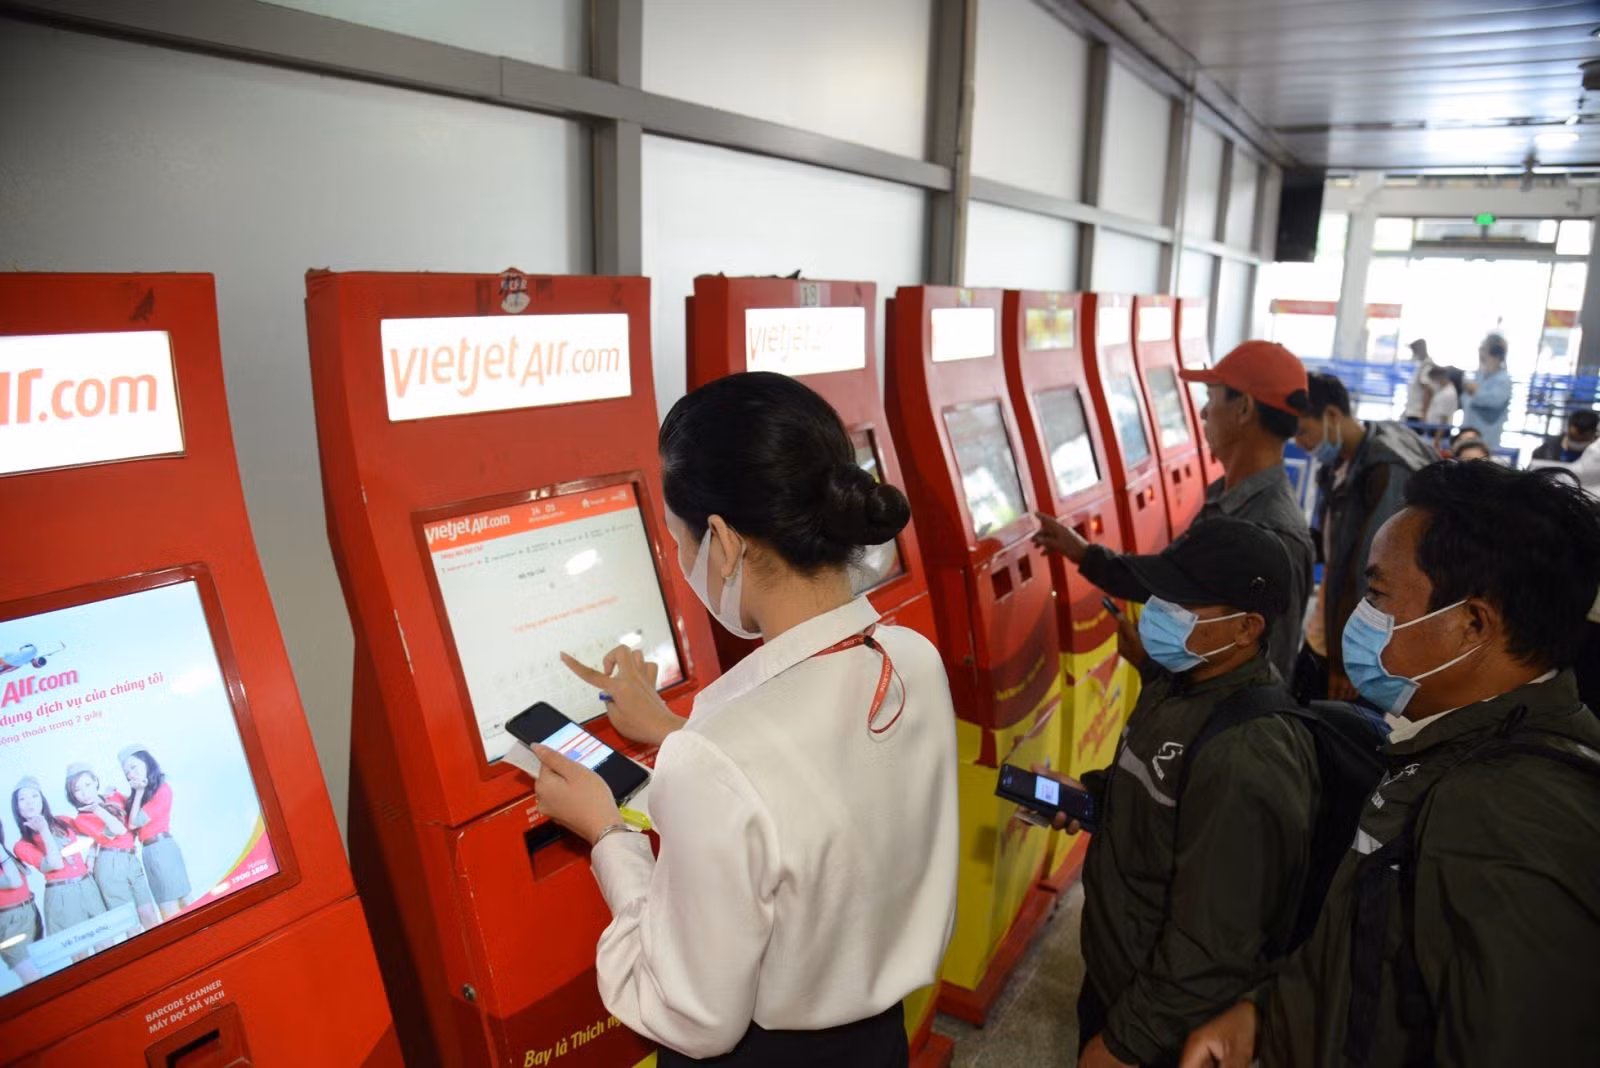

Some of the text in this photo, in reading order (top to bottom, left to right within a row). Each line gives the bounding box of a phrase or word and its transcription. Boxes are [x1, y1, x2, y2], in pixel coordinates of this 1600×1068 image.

[0, 672, 163, 727] dụng dịch vụ của chúng tôi
[49, 718, 74, 732] trong
[145, 979, 222, 1023] BARCODE SCANNER
[524, 1048, 552, 1068] Bay
[555, 1037, 568, 1058] là
[570, 1020, 604, 1049] Thích
